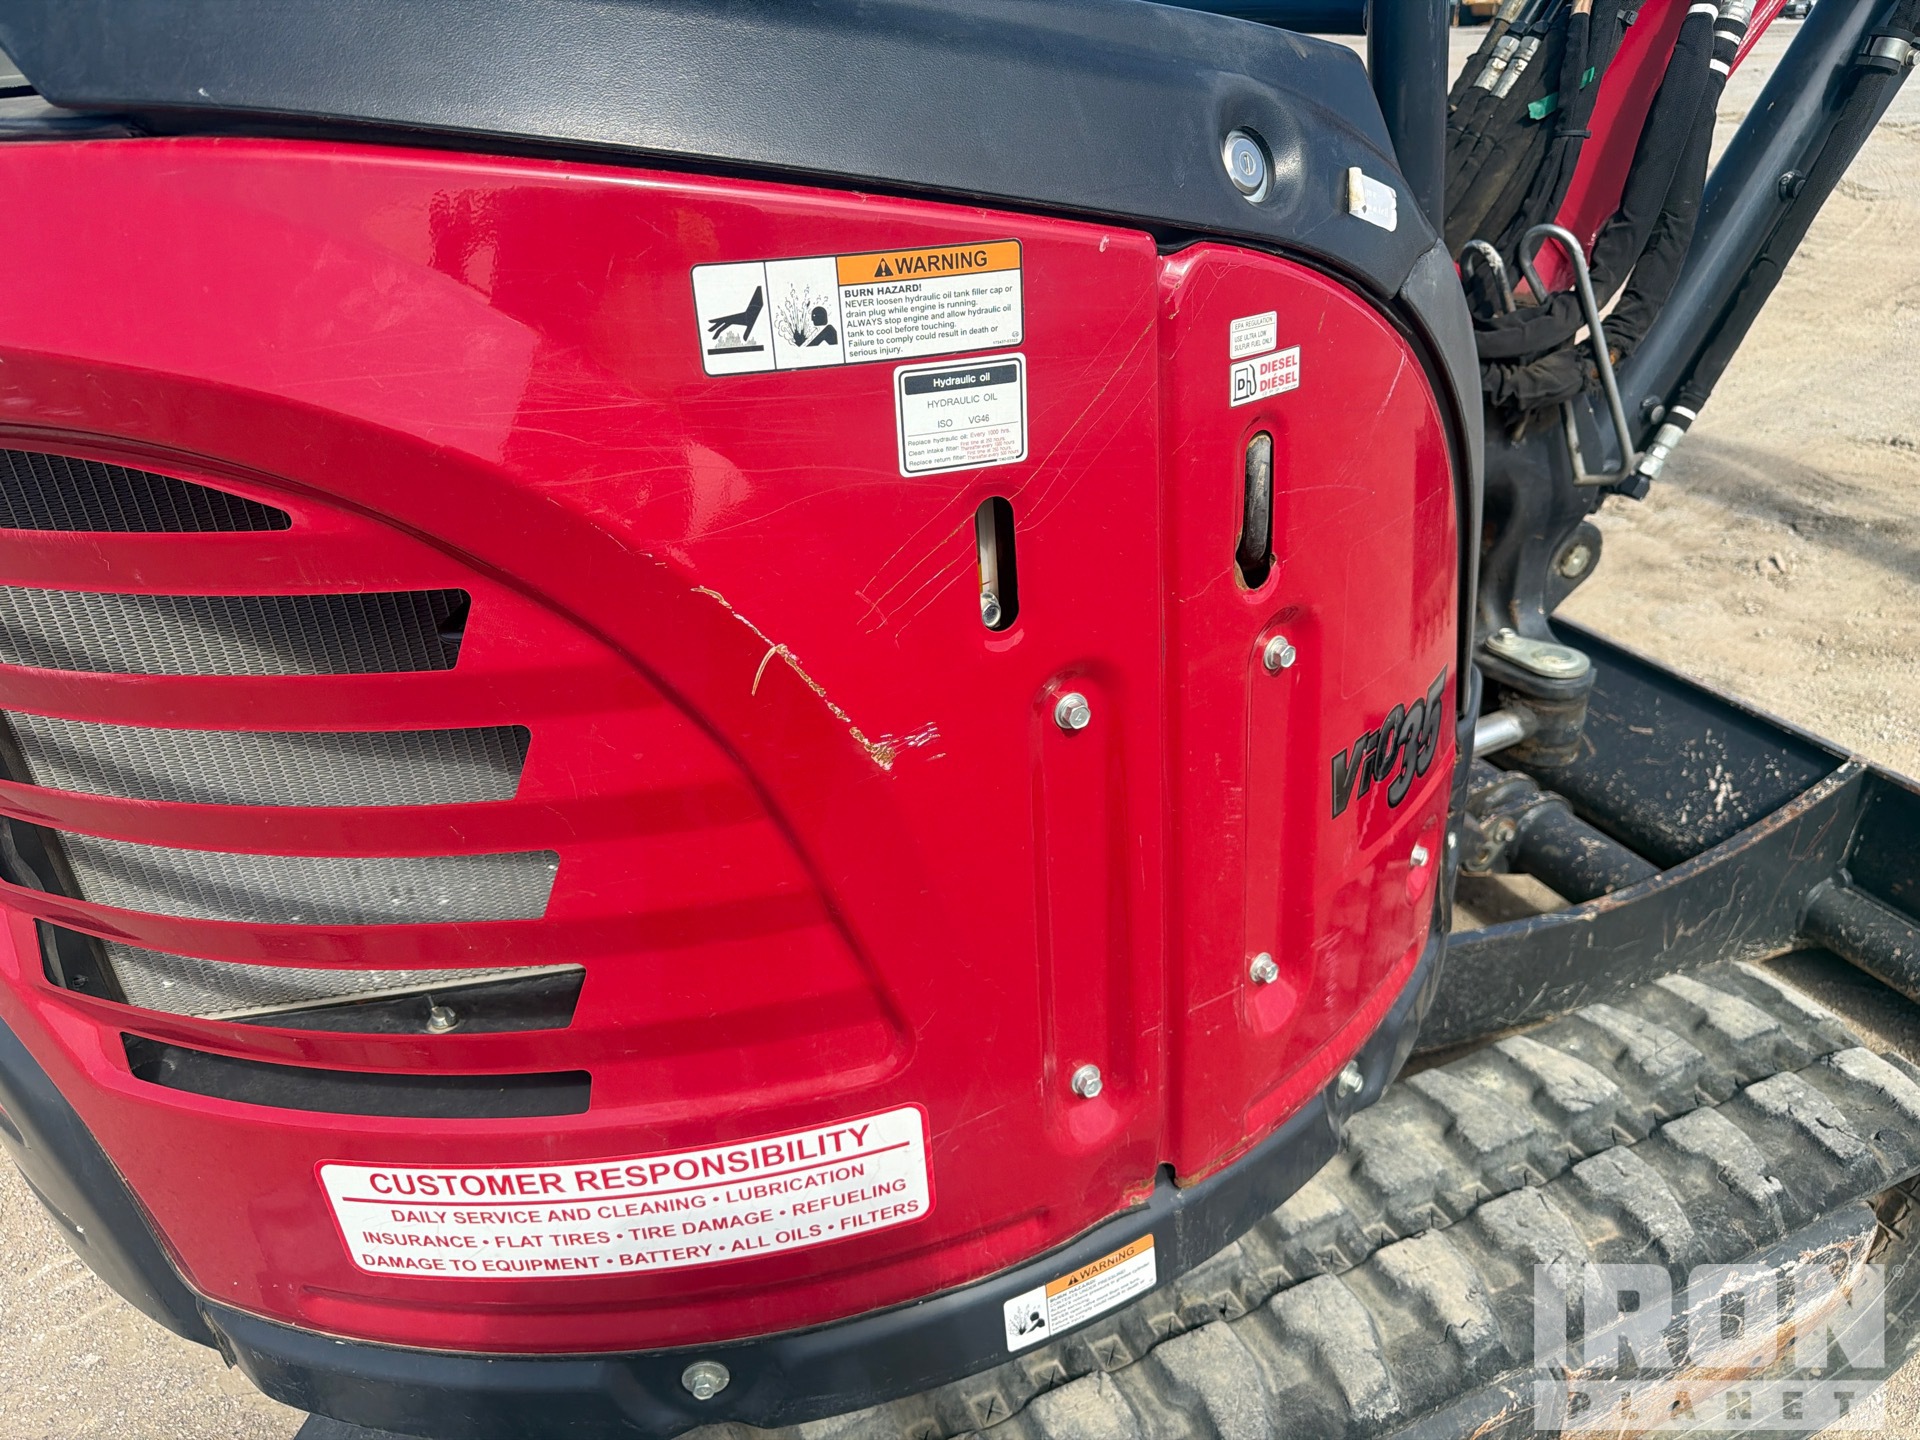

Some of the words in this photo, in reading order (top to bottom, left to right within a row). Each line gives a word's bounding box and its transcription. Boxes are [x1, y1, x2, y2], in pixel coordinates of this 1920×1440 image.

[895, 250, 987, 275] WARNING
[844, 287, 874, 298] BURN
[877, 284, 922, 295] HAZARD!
[845, 299, 874, 308] NEVER
[876, 297, 903, 306] loosen
[905, 293, 940, 304] hydraulic
[943, 291, 952, 299] oil
[953, 290, 970, 298] tank
[972, 287, 988, 296] filler
[846, 310, 866, 318] drain
[869, 308, 886, 317] plug
[888, 305, 908, 314] while
[910, 303, 936, 313] engine
[947, 299, 978, 309] running.
[846, 318, 882, 328] ALWAYS
[885, 316, 901, 325] stop
[903, 314, 929, 323] engine
[931, 311, 945, 320] and
[947, 310, 966, 318] allow
[968, 306, 1001, 317] hydraulic
[1003, 304, 1011, 312] oil
[847, 329, 864, 338] tank
[876, 327, 893, 335] cool
[894, 324, 919, 334] before
[921, 321, 956, 331] touching.
[1235, 322, 1244, 330] EPA
[1245, 316, 1273, 328] REGULATION
[848, 339, 875, 347] Failure
[886, 335, 914, 344] comply
[916, 331, 936, 340] could
[938, 329, 959, 338] result
[960, 328, 967, 336] in
[969, 326, 989, 335] death
[1234, 335, 1243, 343] USE
[1244, 333, 1257, 341] ULTRA
[1234, 342, 1250, 351] SULFUR
[1262, 337, 1272, 345] ONLY
[849, 347, 878, 357] serious
[879, 346, 903, 355] injury.
[1260, 355, 1297, 375] DIESEL
[933, 375, 976, 388] Hydraulic
[979, 372, 990, 382] oil
[1237, 378, 1245, 391] D
[1259, 371, 1297, 392] DIÉSEL
[927, 394, 980, 408] HYDRAULIC
[983, 393, 998, 402] OIL
[938, 419, 953, 428] ISO
[968, 414, 990, 424] VG46
[933, 435, 958, 443] hydraulic
[909, 459, 932, 467] Replace
[369, 1172, 566, 1197] CUSTOMER
[574, 1123, 870, 1192] RESPONSIBILITY
[391, 1209, 447, 1224] DAILY
[453, 1210, 542, 1225] SERVICE
[548, 1207, 591, 1222] AND
[597, 1195, 707, 1219] CLEANING
[726, 1163, 865, 1203] LUBRICATION
[362, 1231, 478, 1248] INSURANCE
[495, 1235, 543, 1248] FLAT
[549, 1231, 611, 1247] TIRES
[628, 1224, 677, 1241] TIRE
[682, 1208, 775, 1235] DAMAGE
[792, 1178, 907, 1216] REFUELING
[362, 1253, 446, 1271] DAMAGE
[449, 1258, 477, 1271] TO
[482, 1256, 600, 1272] EQUIPMENT
[619, 1244, 713, 1266] BATTERY
[731, 1235, 770, 1252] ALL
[775, 1224, 822, 1244] OILS
[840, 1199, 919, 1230] FILTERS
[1080, 1246, 1135, 1279] WARNING
